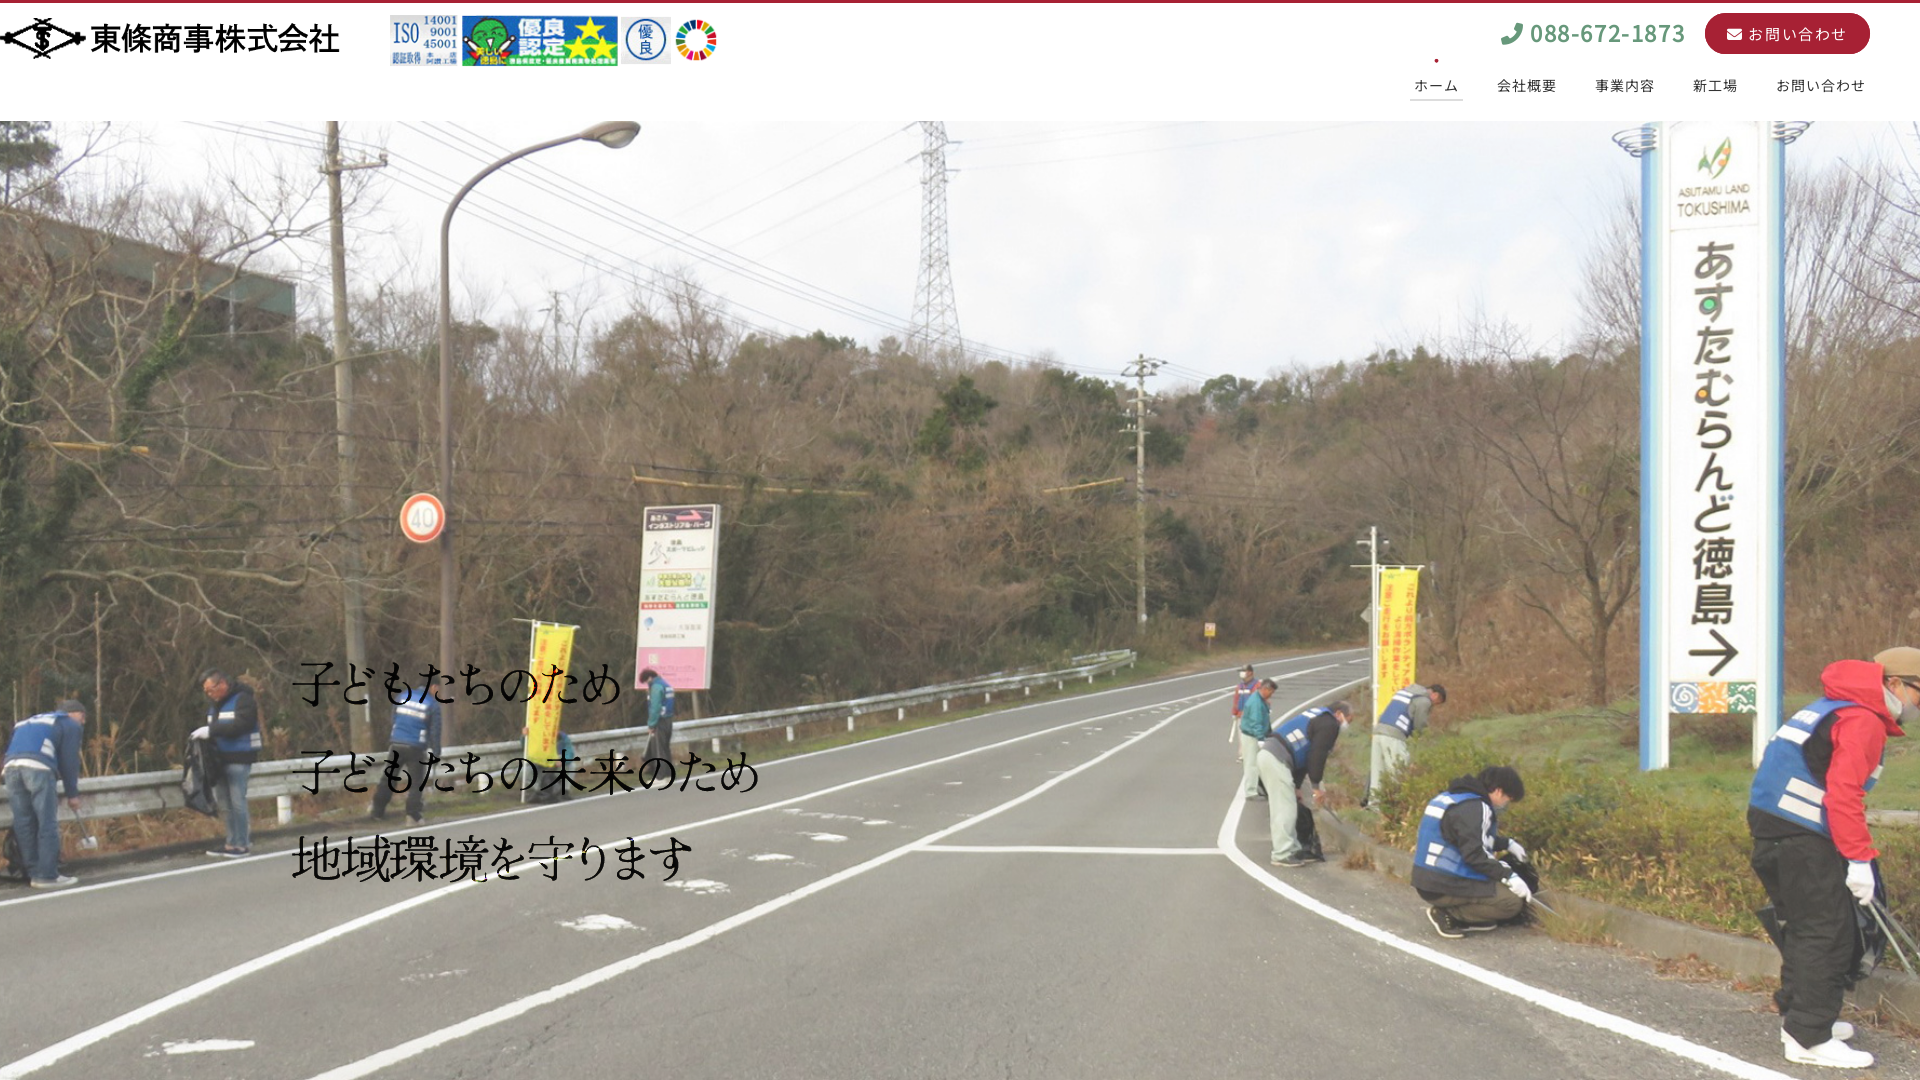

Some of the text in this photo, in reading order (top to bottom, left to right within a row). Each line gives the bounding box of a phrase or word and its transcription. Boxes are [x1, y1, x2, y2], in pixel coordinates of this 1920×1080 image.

[1678, 183, 1750, 198] ASUTAMU LAND
[1676, 199, 1751, 217] TOKUSHIMA
[1691, 241, 1735, 625] あすたむらんど徳島
[411, 508, 434, 528] 40
